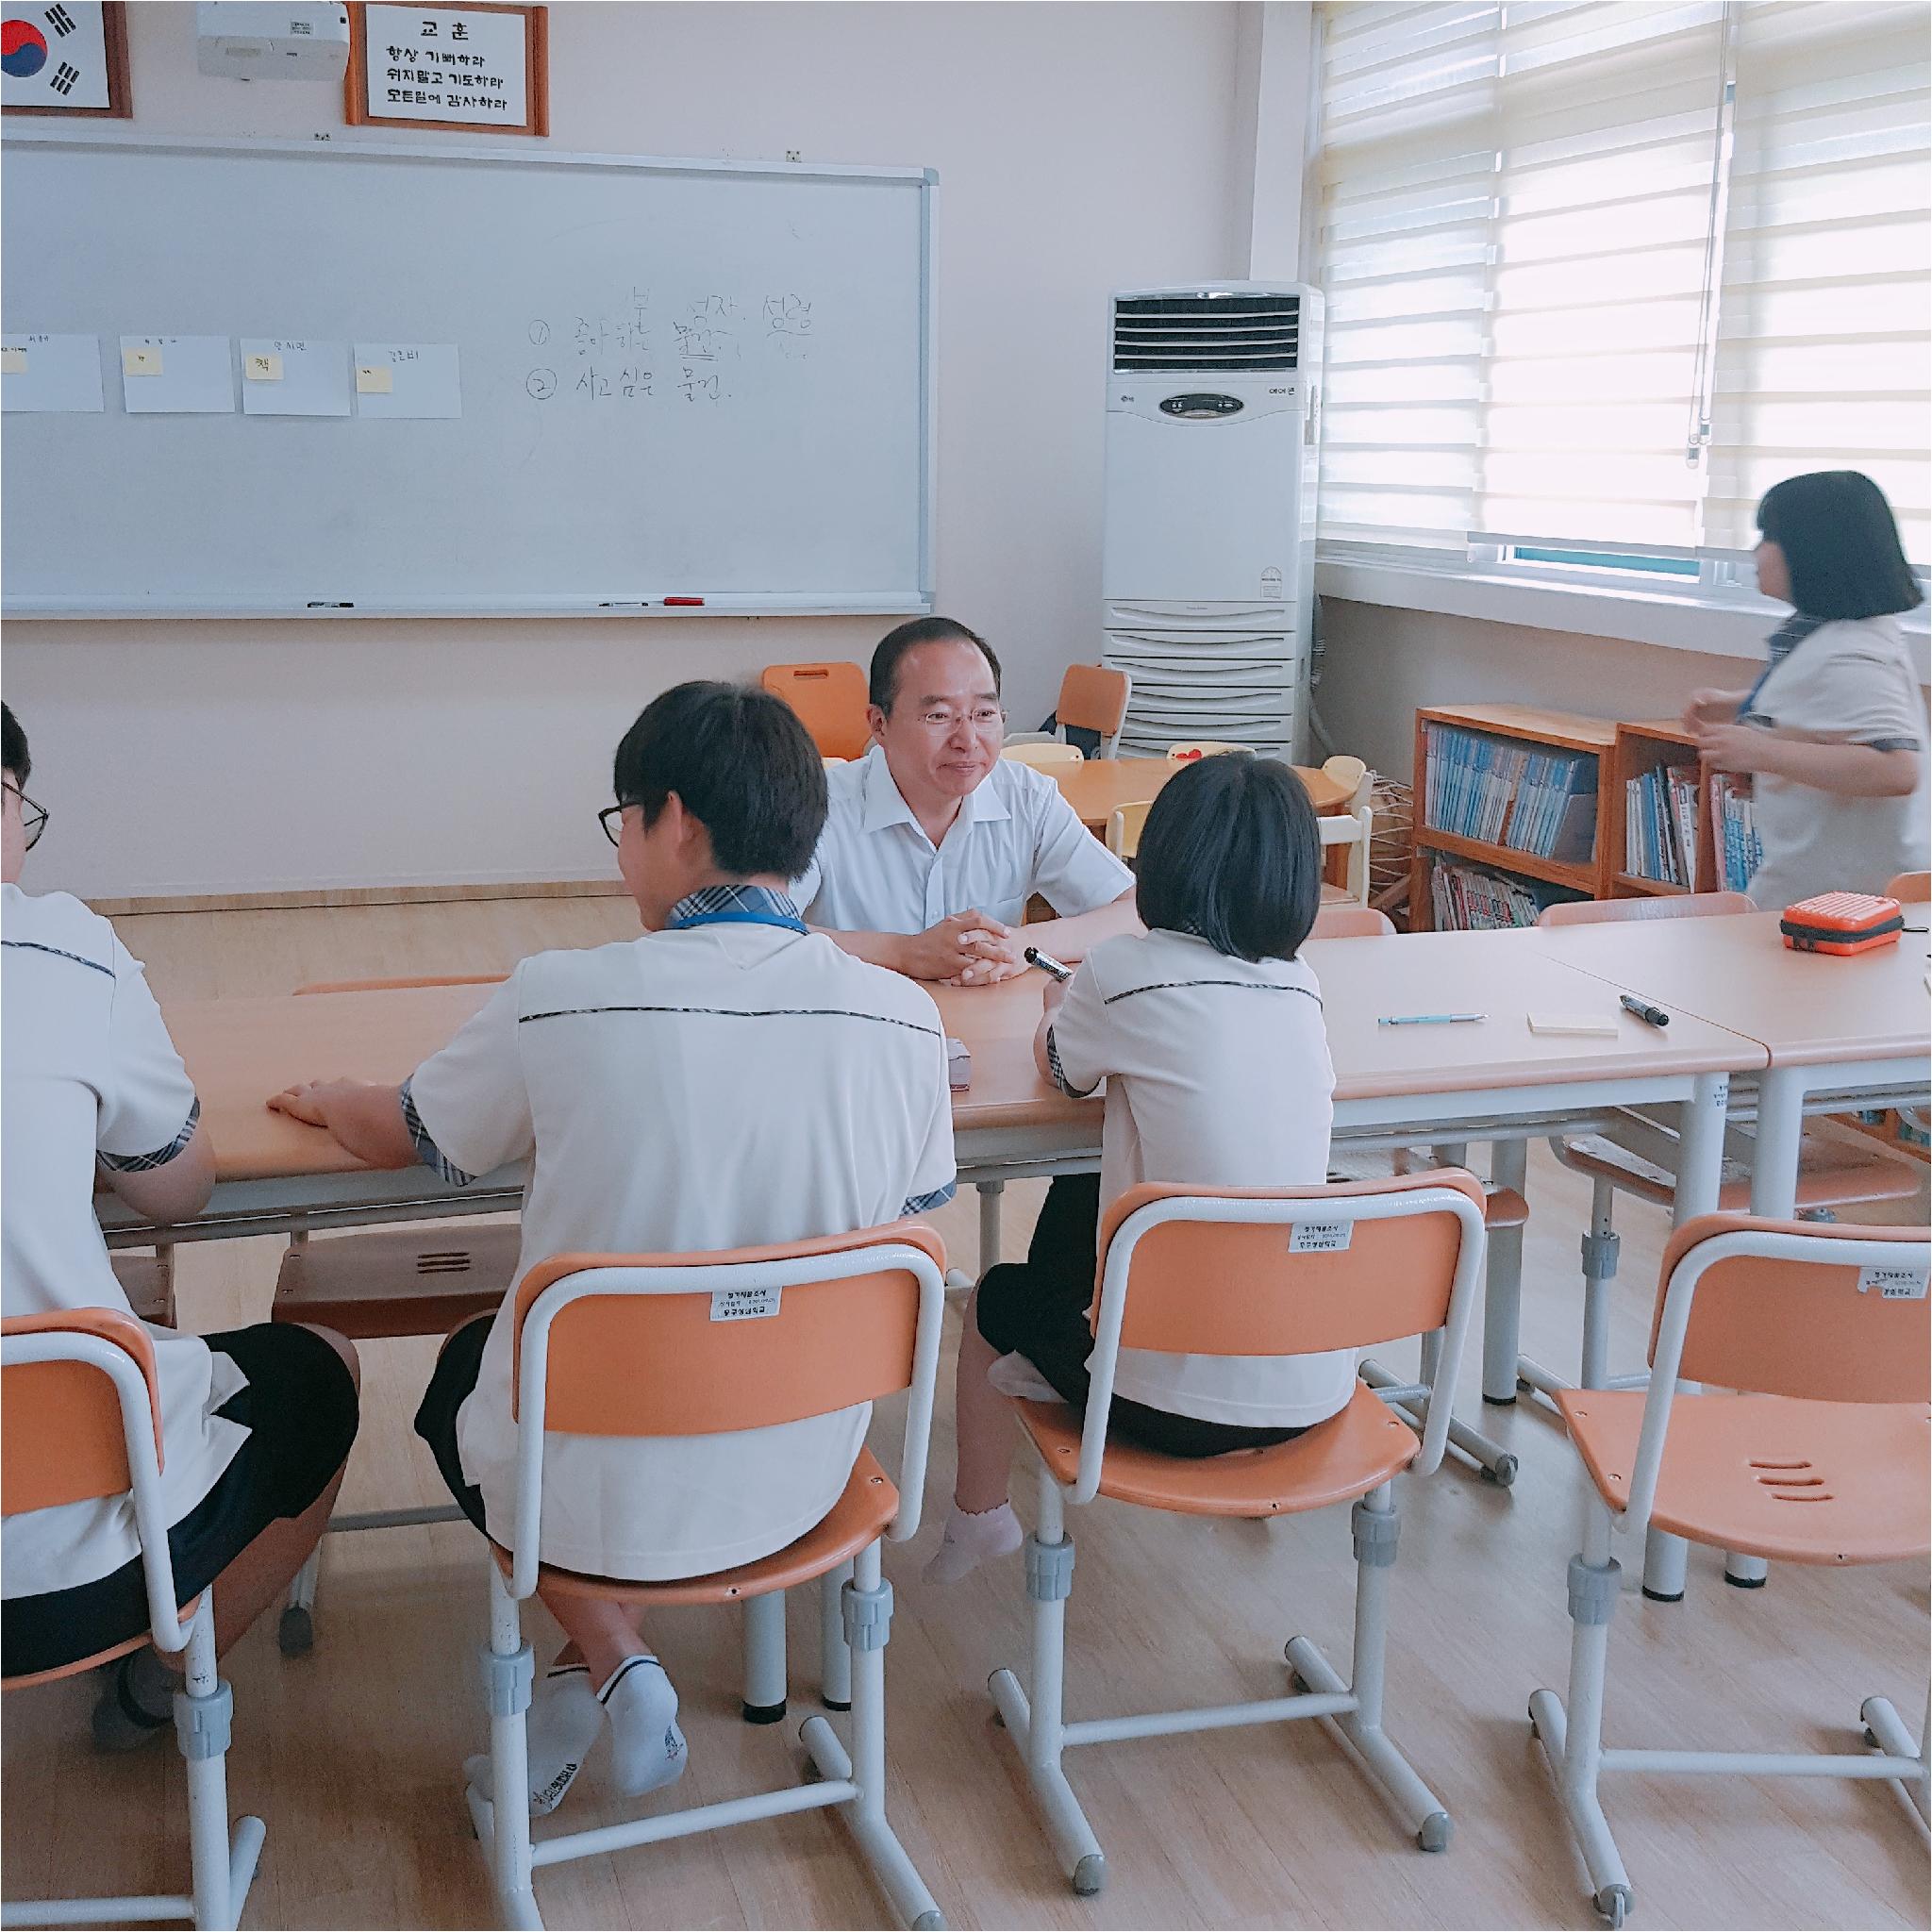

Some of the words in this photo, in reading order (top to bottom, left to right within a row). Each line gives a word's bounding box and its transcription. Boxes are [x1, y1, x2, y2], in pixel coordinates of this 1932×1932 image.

[386, 45, 419, 62] 항상
[425, 51, 486, 68] 기뻐하라
[448, 74, 504, 90] 기도하라
[446, 94, 508, 111] 감사하라
